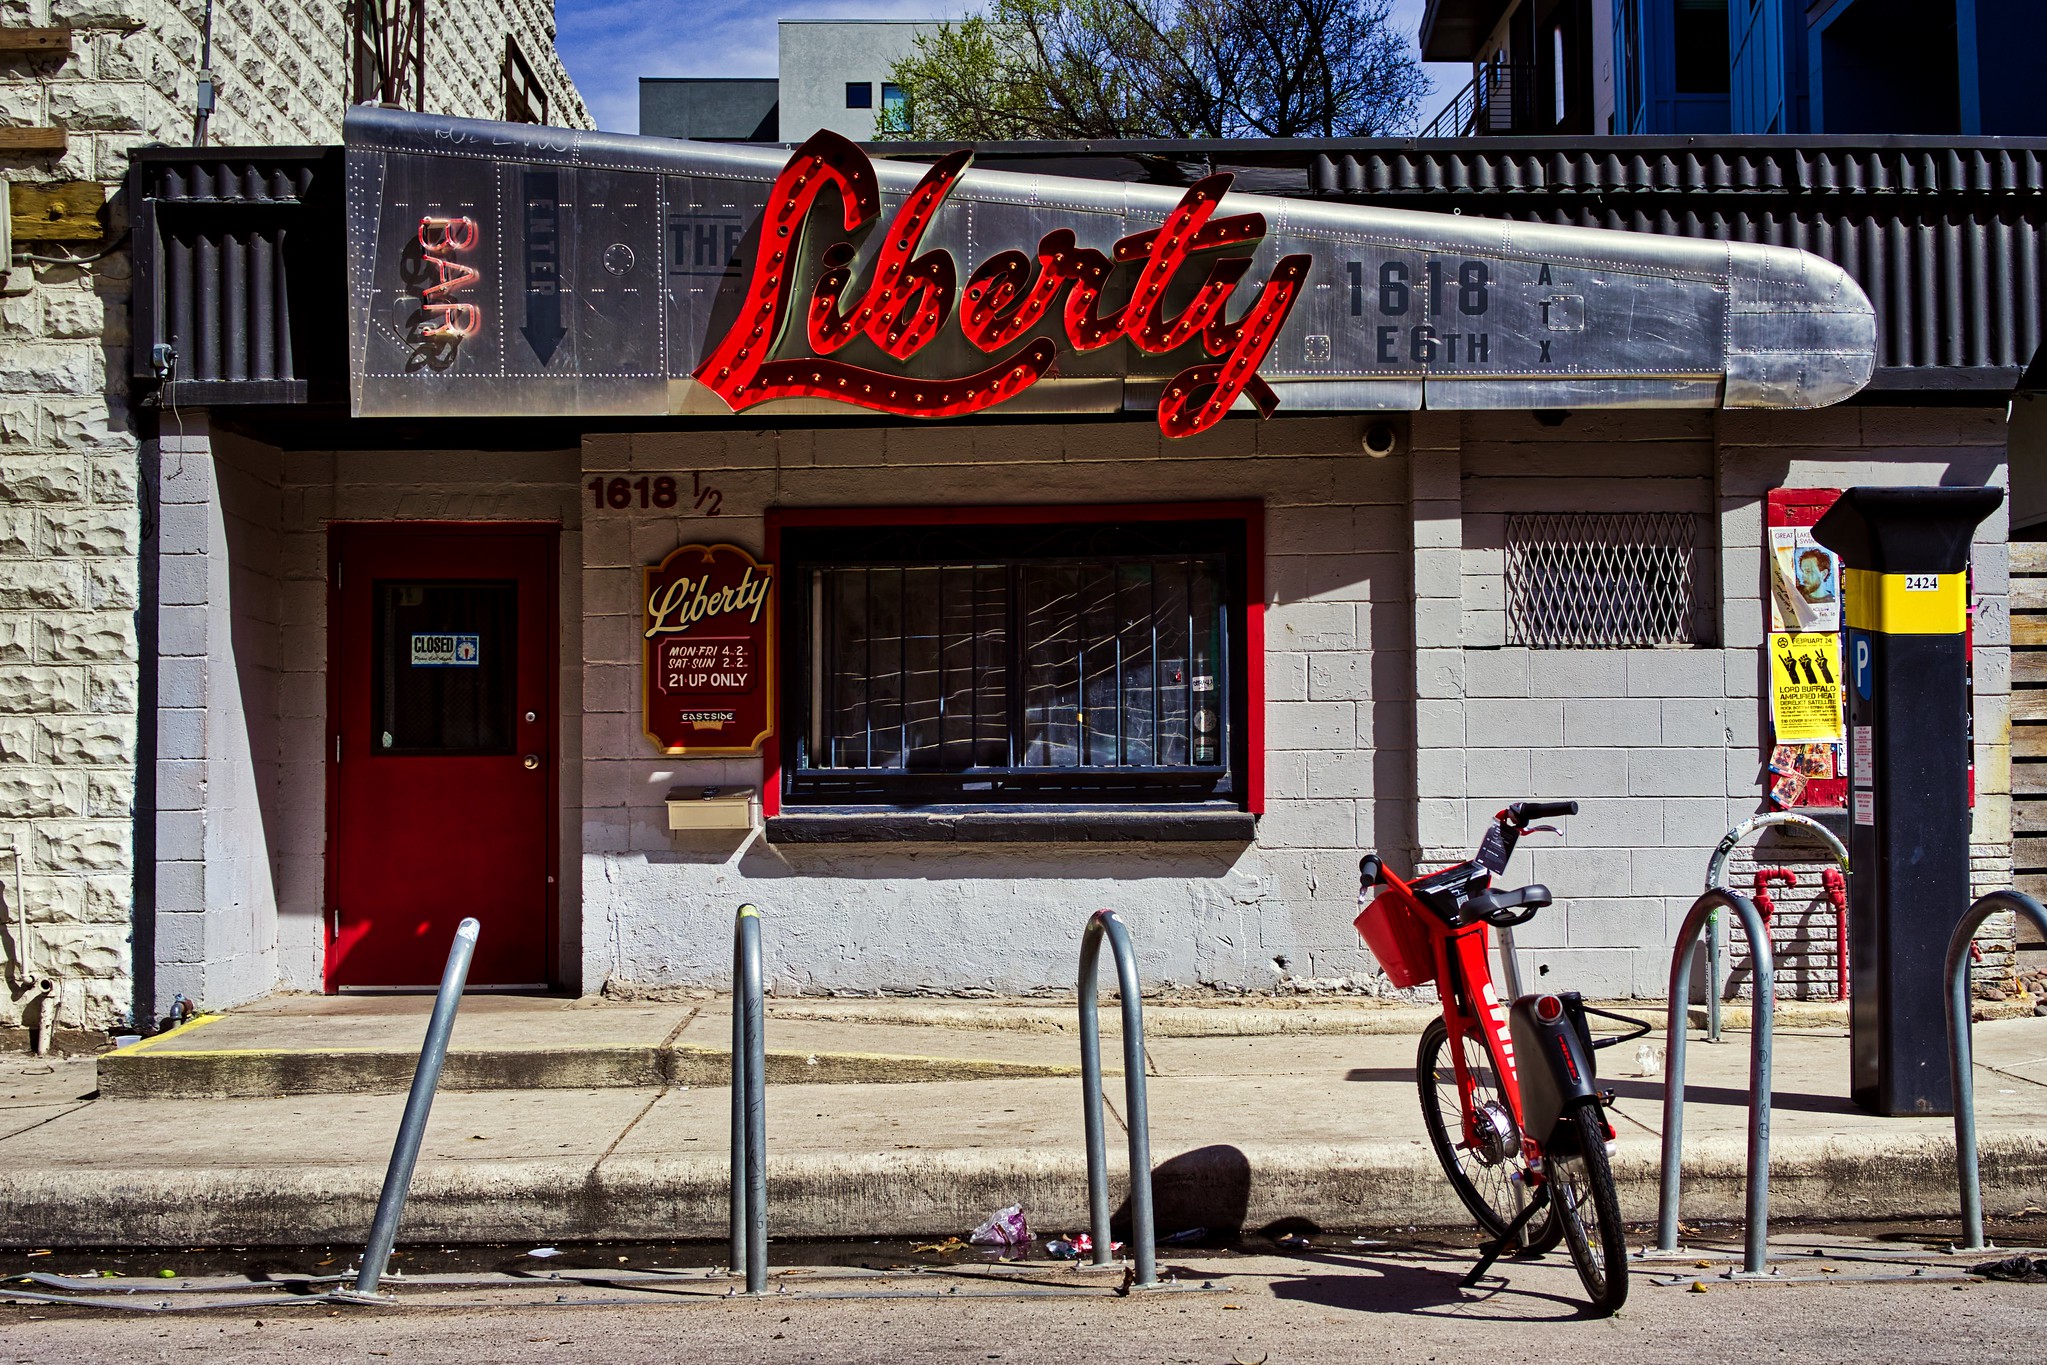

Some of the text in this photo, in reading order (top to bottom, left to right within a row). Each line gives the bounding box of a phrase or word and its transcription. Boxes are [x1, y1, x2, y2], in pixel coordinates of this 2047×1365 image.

[529, 198, 556, 296] ENTER
[669, 224, 742, 267] THE
[418, 216, 476, 336] BAR
[691, 129, 1312, 439] Liberty
[1346, 261, 1488, 316] 1618
[588, 476, 677, 509] 1618
[645, 567, 771, 638] Liberty
[1906, 577, 1937, 589] 2424
[414, 637, 453, 653] CLOSED
[1857, 641, 1869, 687] P
[710, 673, 748, 687] ONLY
